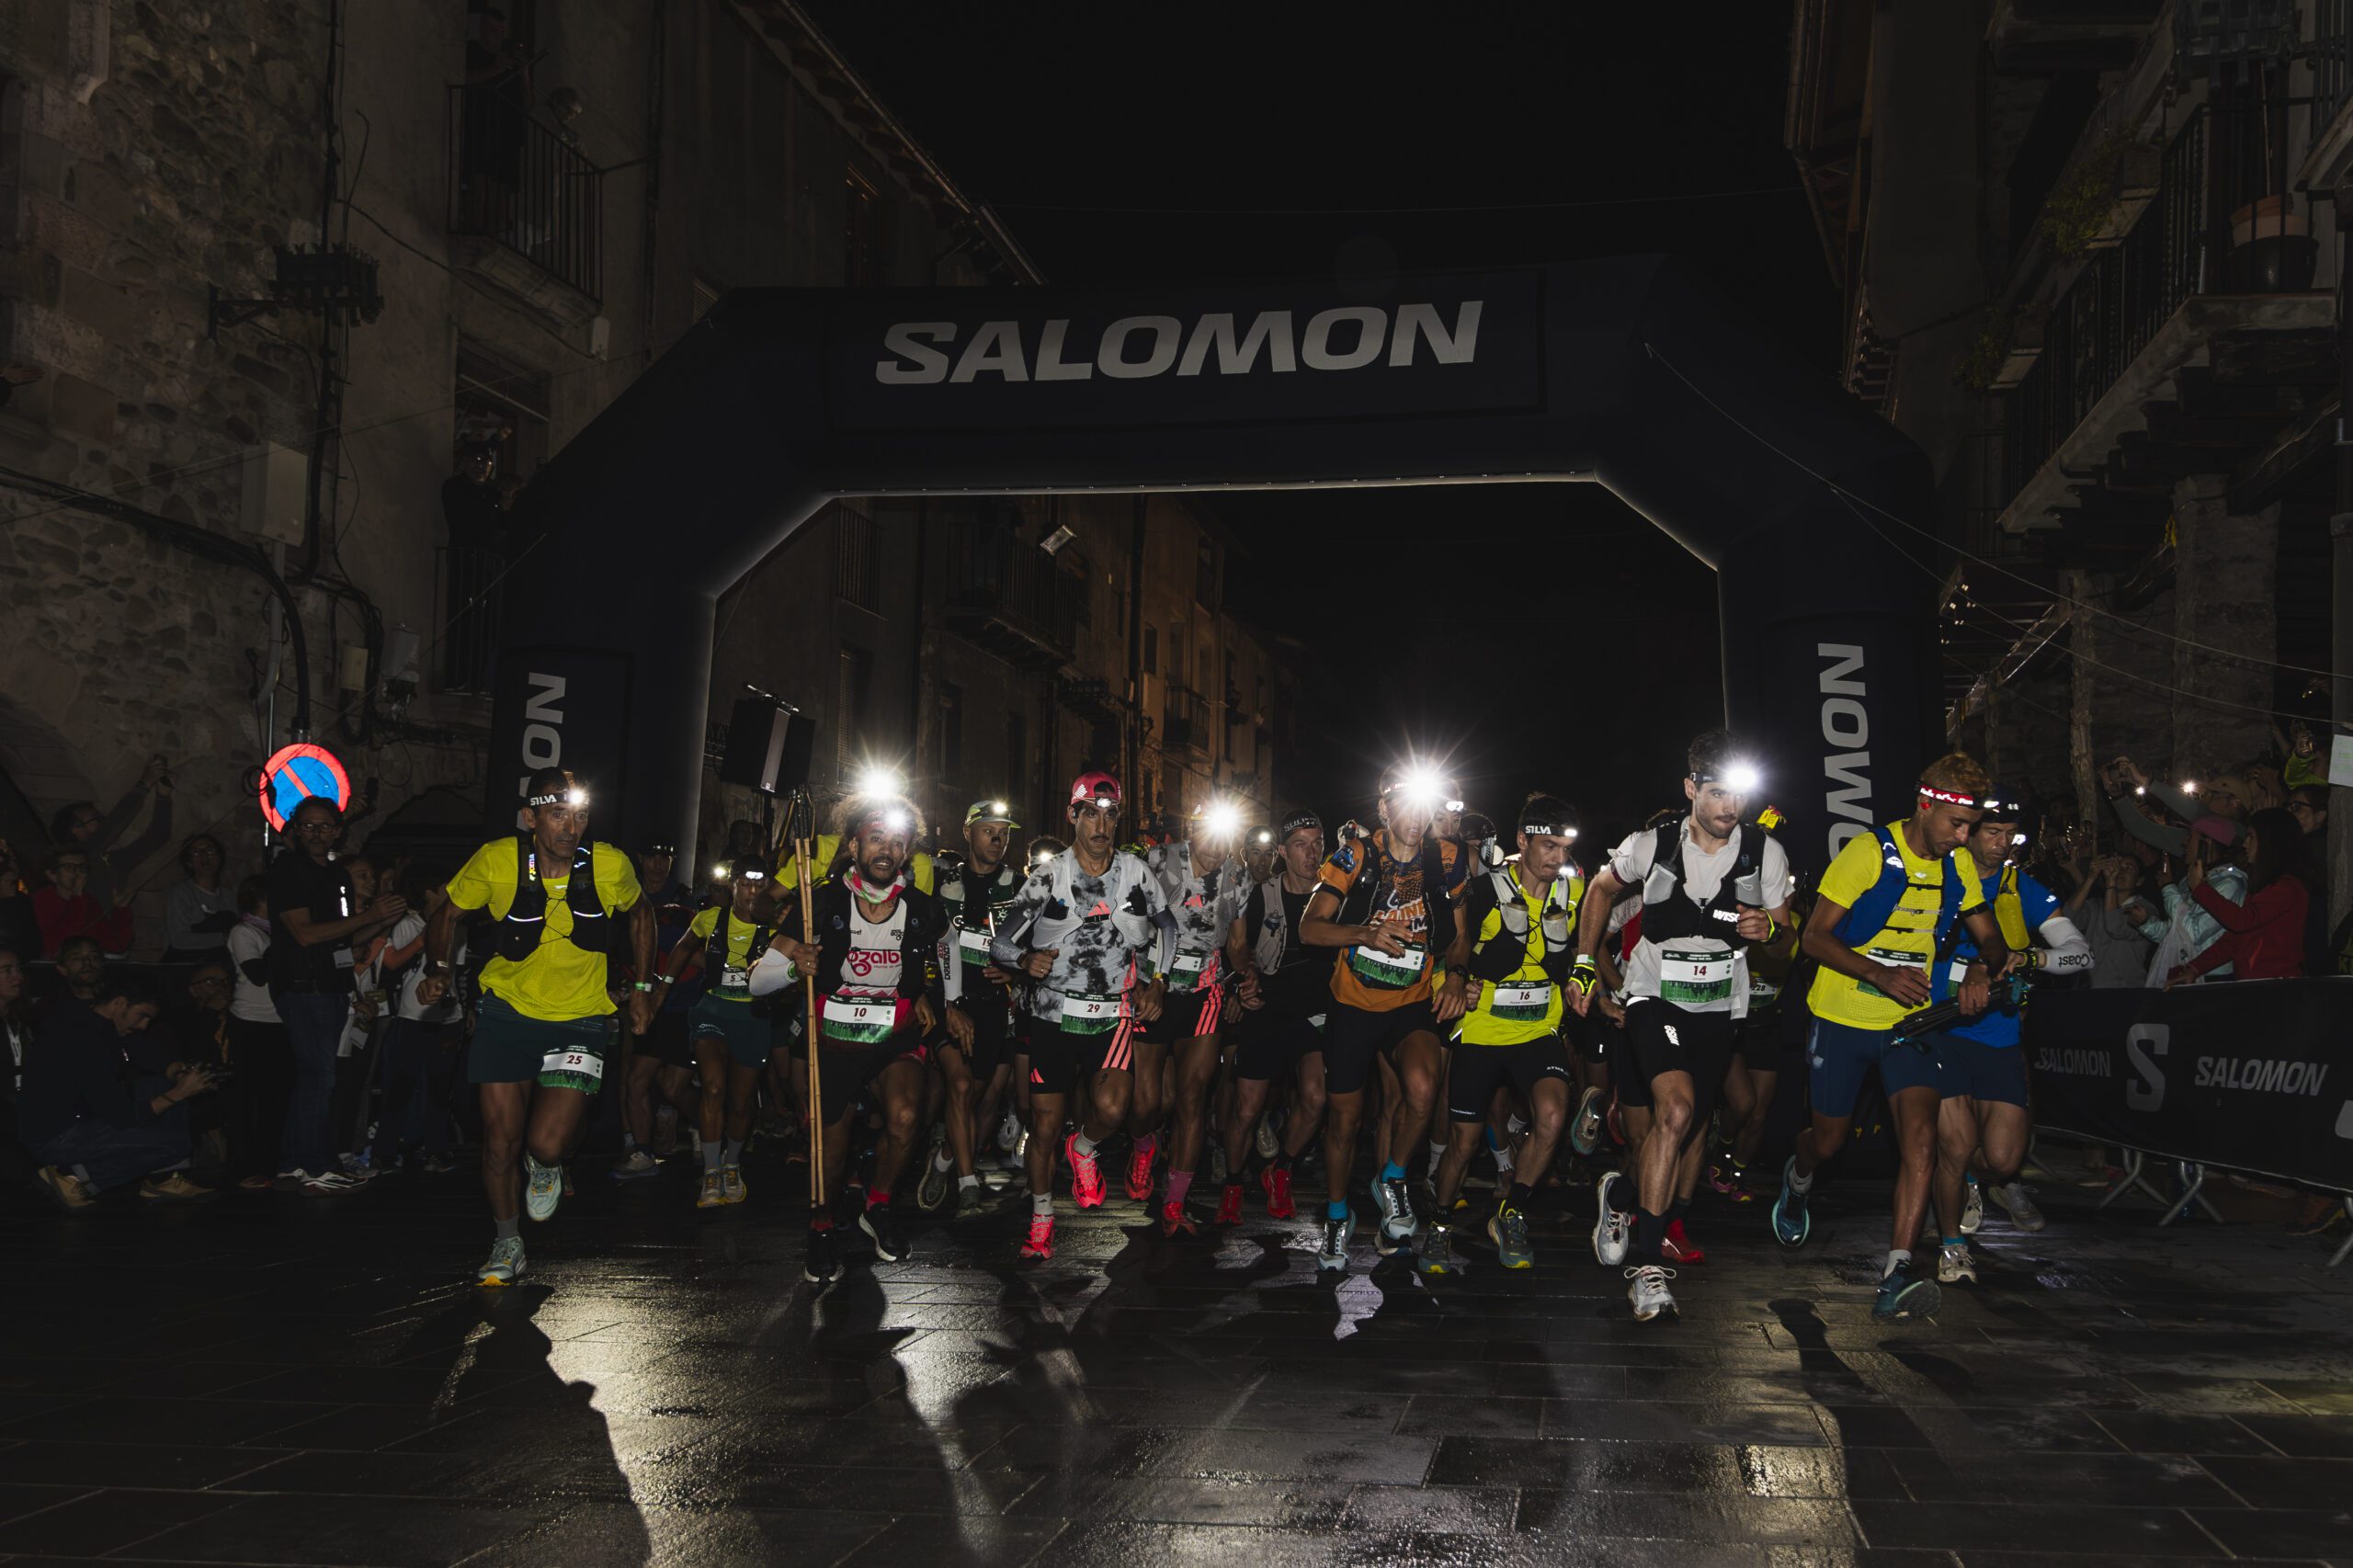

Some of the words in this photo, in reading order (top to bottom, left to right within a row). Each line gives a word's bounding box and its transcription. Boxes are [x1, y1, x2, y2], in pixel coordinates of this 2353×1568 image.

[876, 300, 1484, 385] SALOMON
[530, 794, 558, 806] SILVA
[1525, 824, 1552, 835] SILVA
[982, 937, 993, 947] 19
[2059, 953, 2090, 968] Coast
[1694, 965, 1707, 976] 14
[1519, 991, 1530, 1001] 16
[854, 1007, 868, 1017] 10
[1086, 1003, 1101, 1013] 29
[565, 1054, 583, 1065] 25
[2033, 1047, 2112, 1077] SALOMON
[2194, 1056, 2330, 1096] SALOMON
